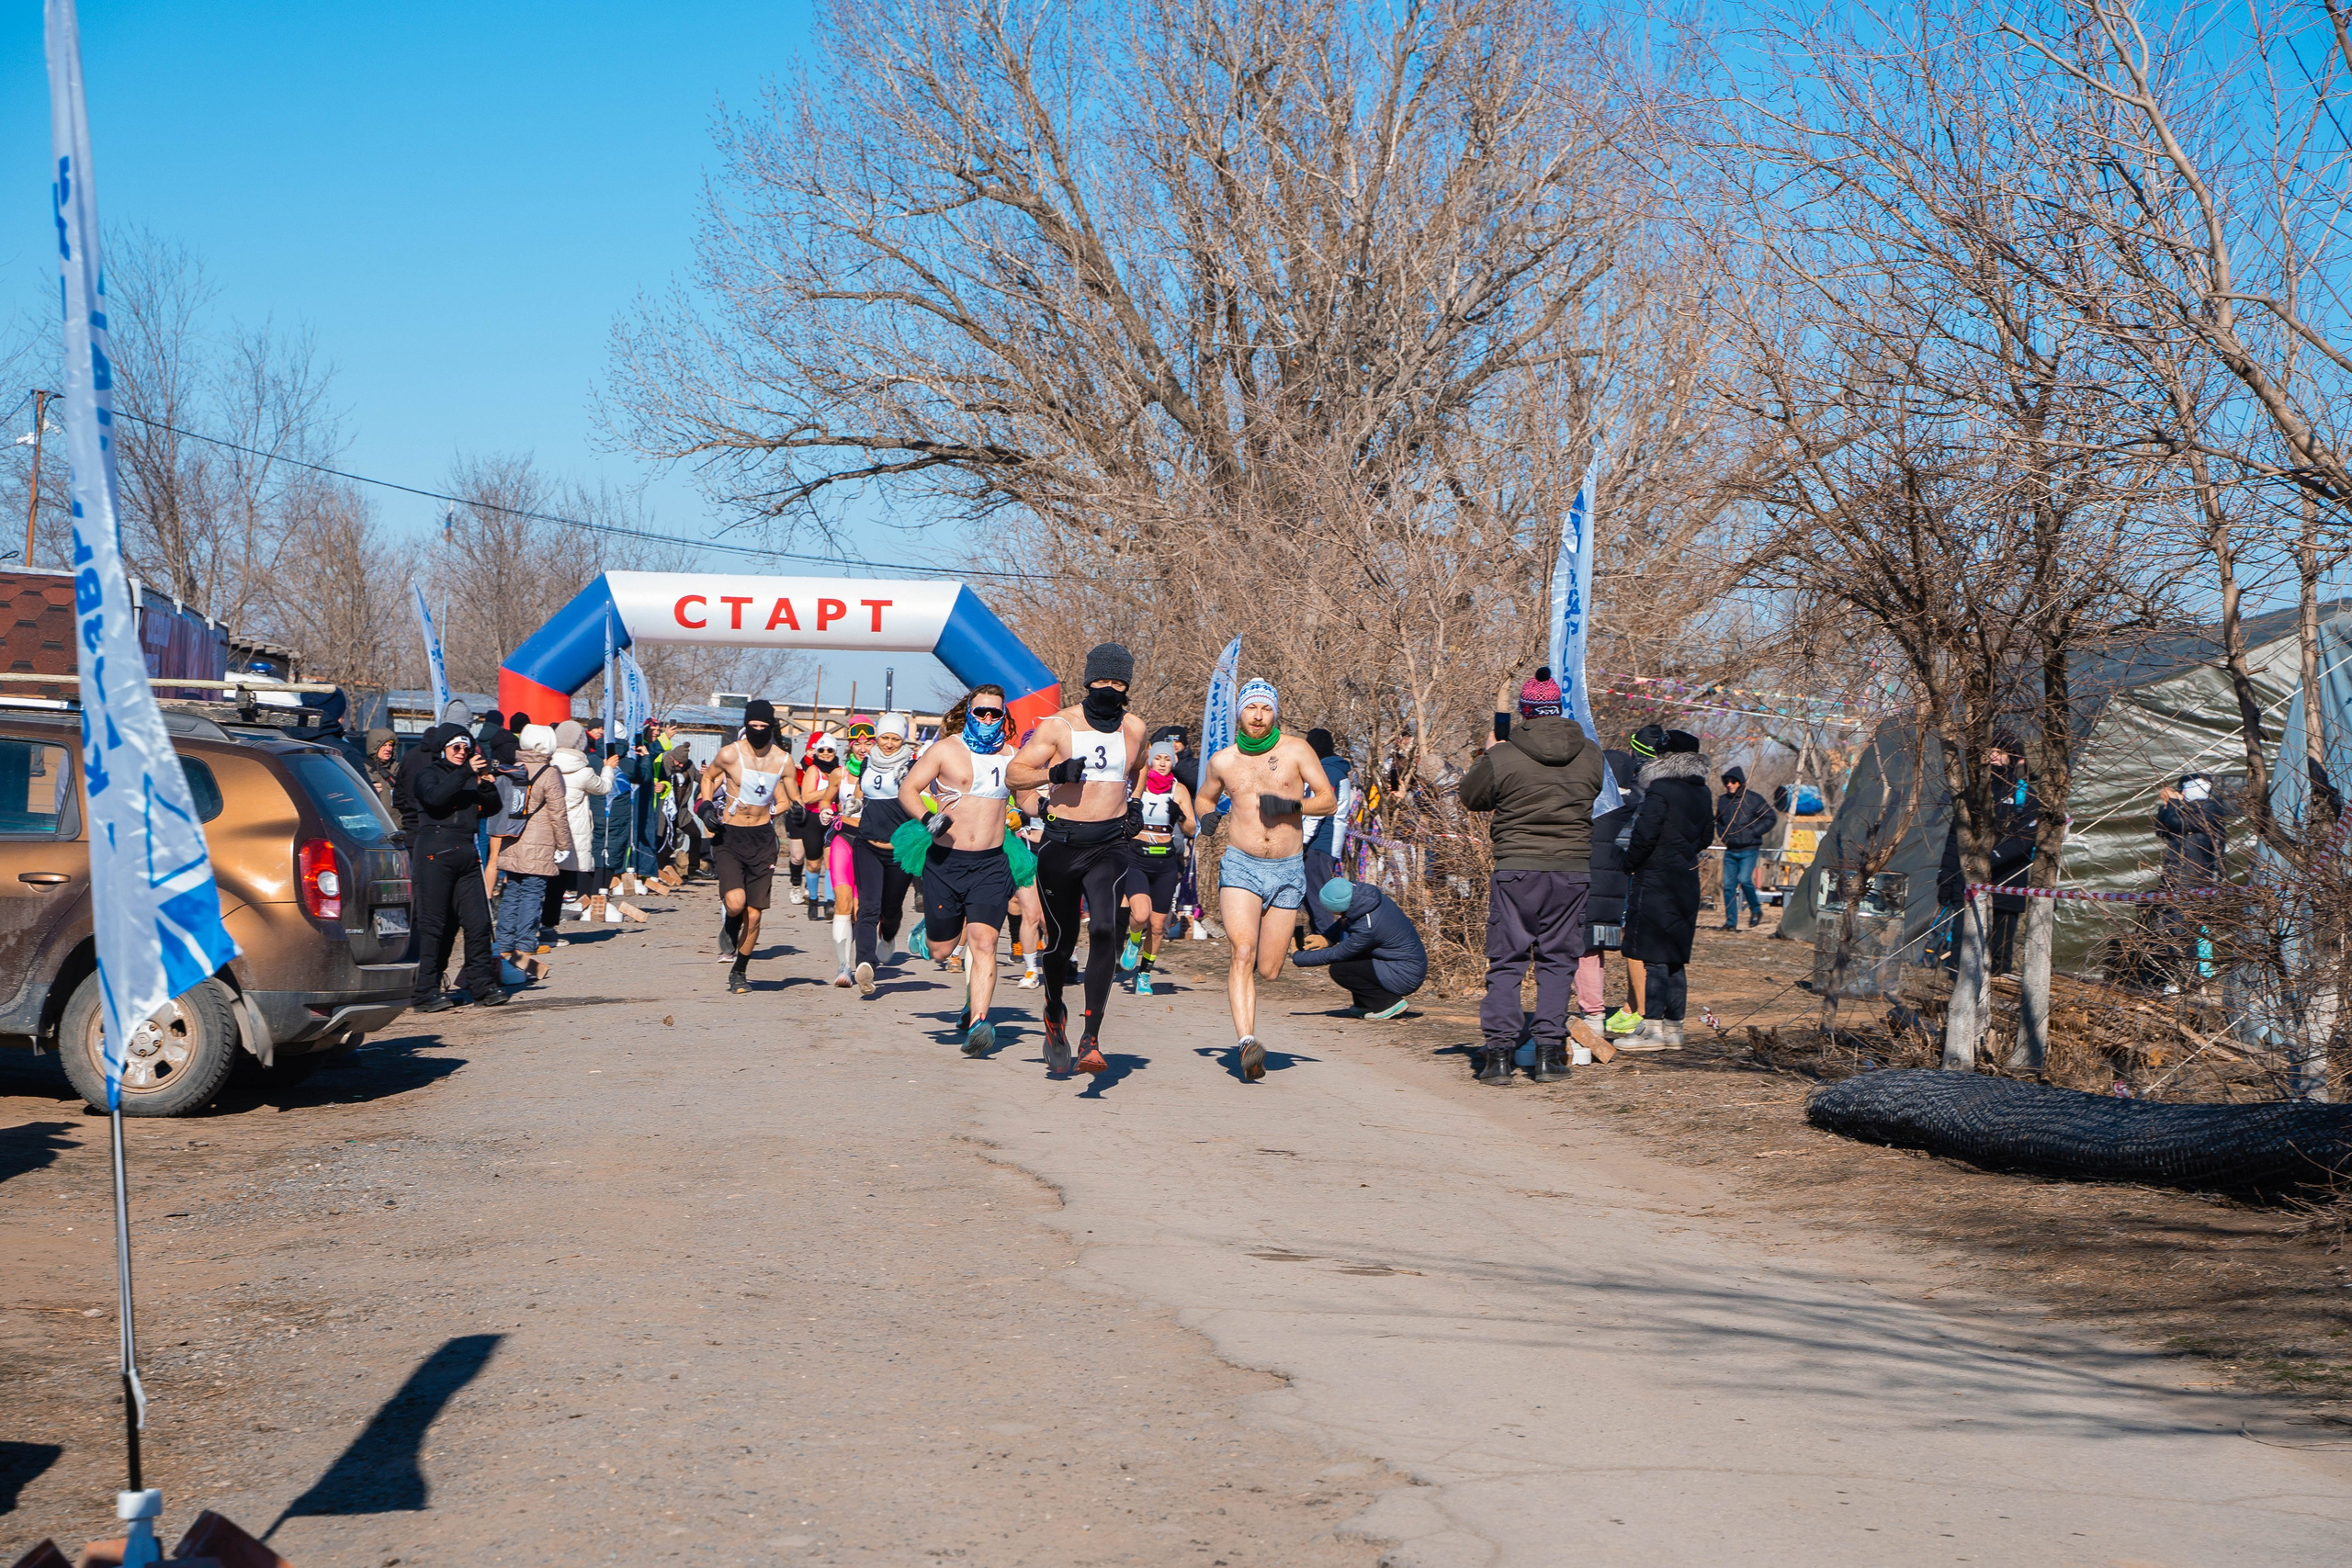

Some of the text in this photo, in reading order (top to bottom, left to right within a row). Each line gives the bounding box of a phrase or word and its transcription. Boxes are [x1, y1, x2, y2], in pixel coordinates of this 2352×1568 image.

[673, 594, 893, 632] СТАРТ
[1095, 745, 1107, 770] 3
[874, 774, 882, 790] 9
[991, 766, 1000, 787] 1
[754, 784, 766, 797] 4
[1148, 802, 1158, 817] 7
